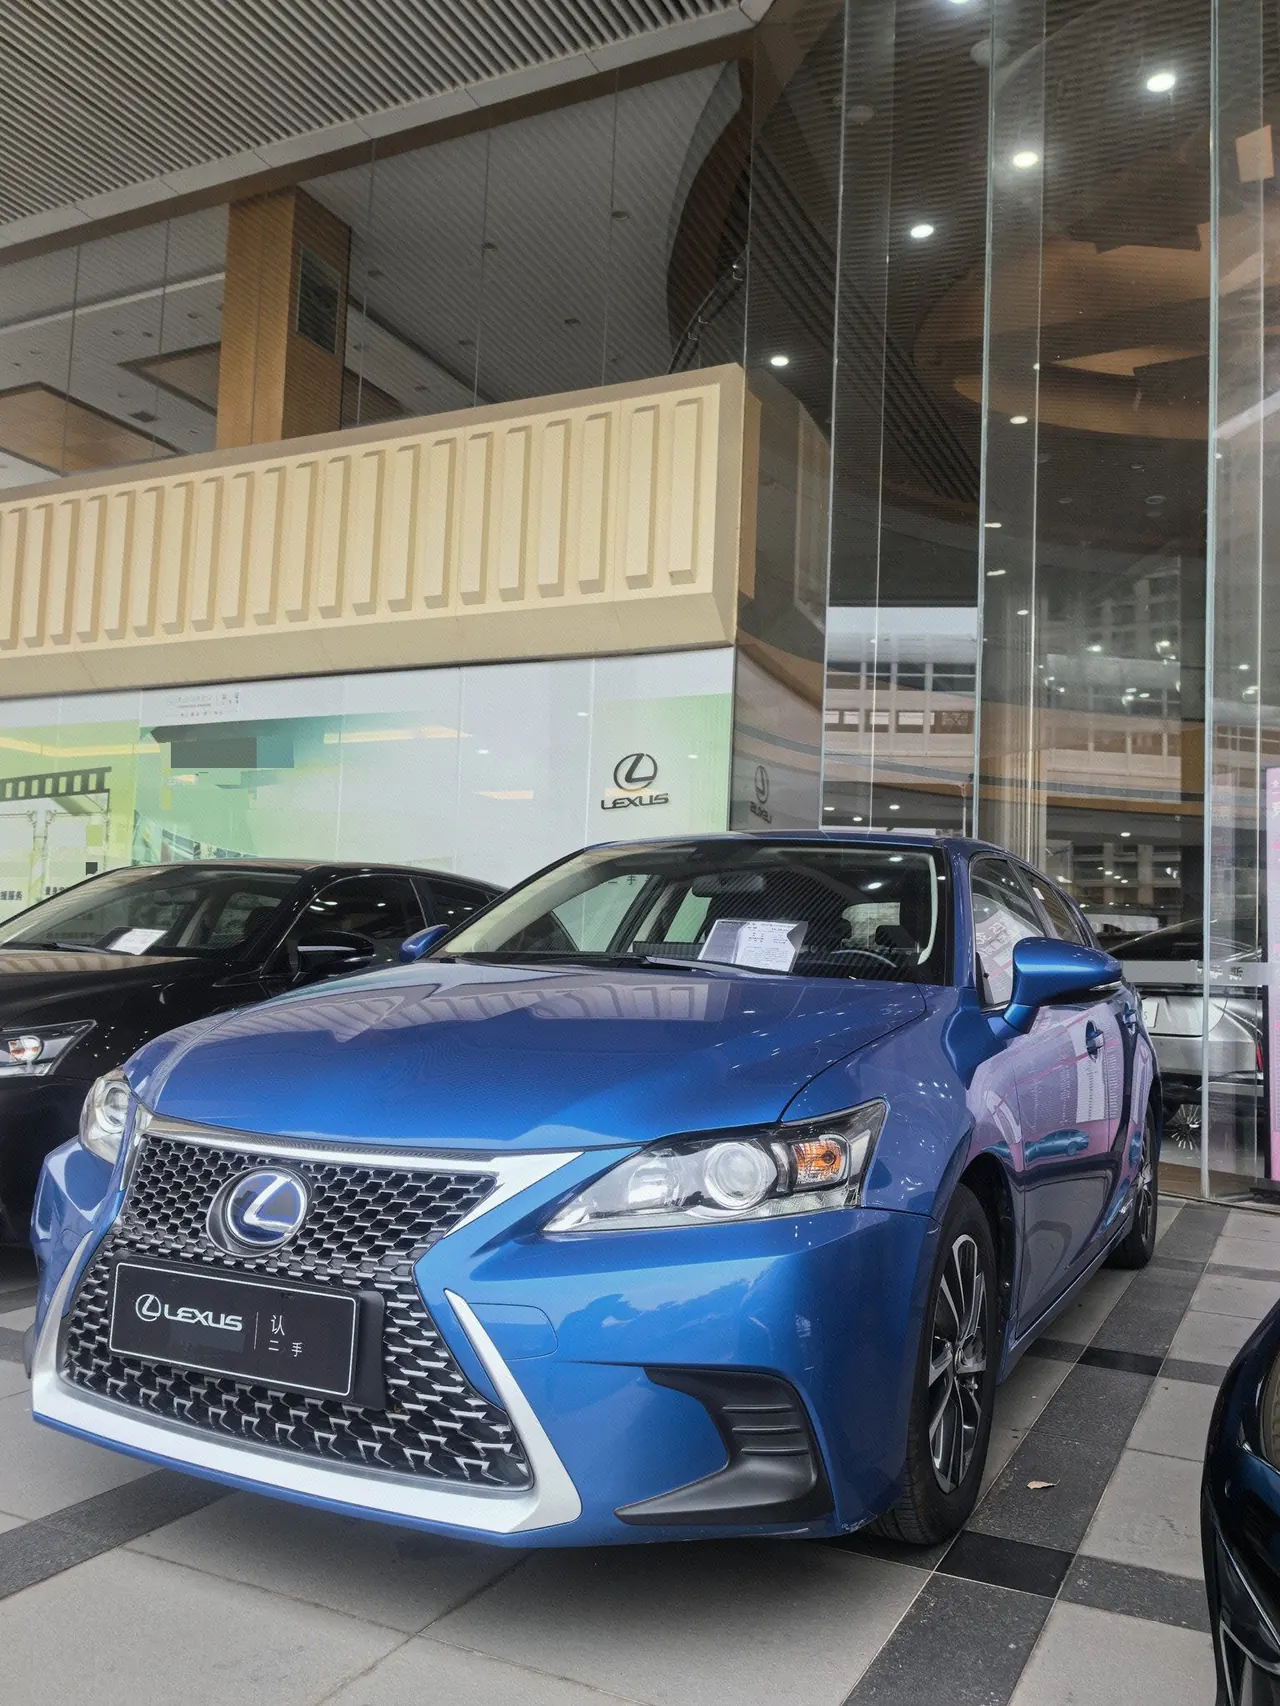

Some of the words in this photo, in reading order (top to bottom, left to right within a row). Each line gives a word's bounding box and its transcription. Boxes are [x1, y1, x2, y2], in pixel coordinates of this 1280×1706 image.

[601, 793, 669, 810] LEXUS
[164, 1304, 243, 1332] LEXUS
[270, 1314, 286, 1336] 认
